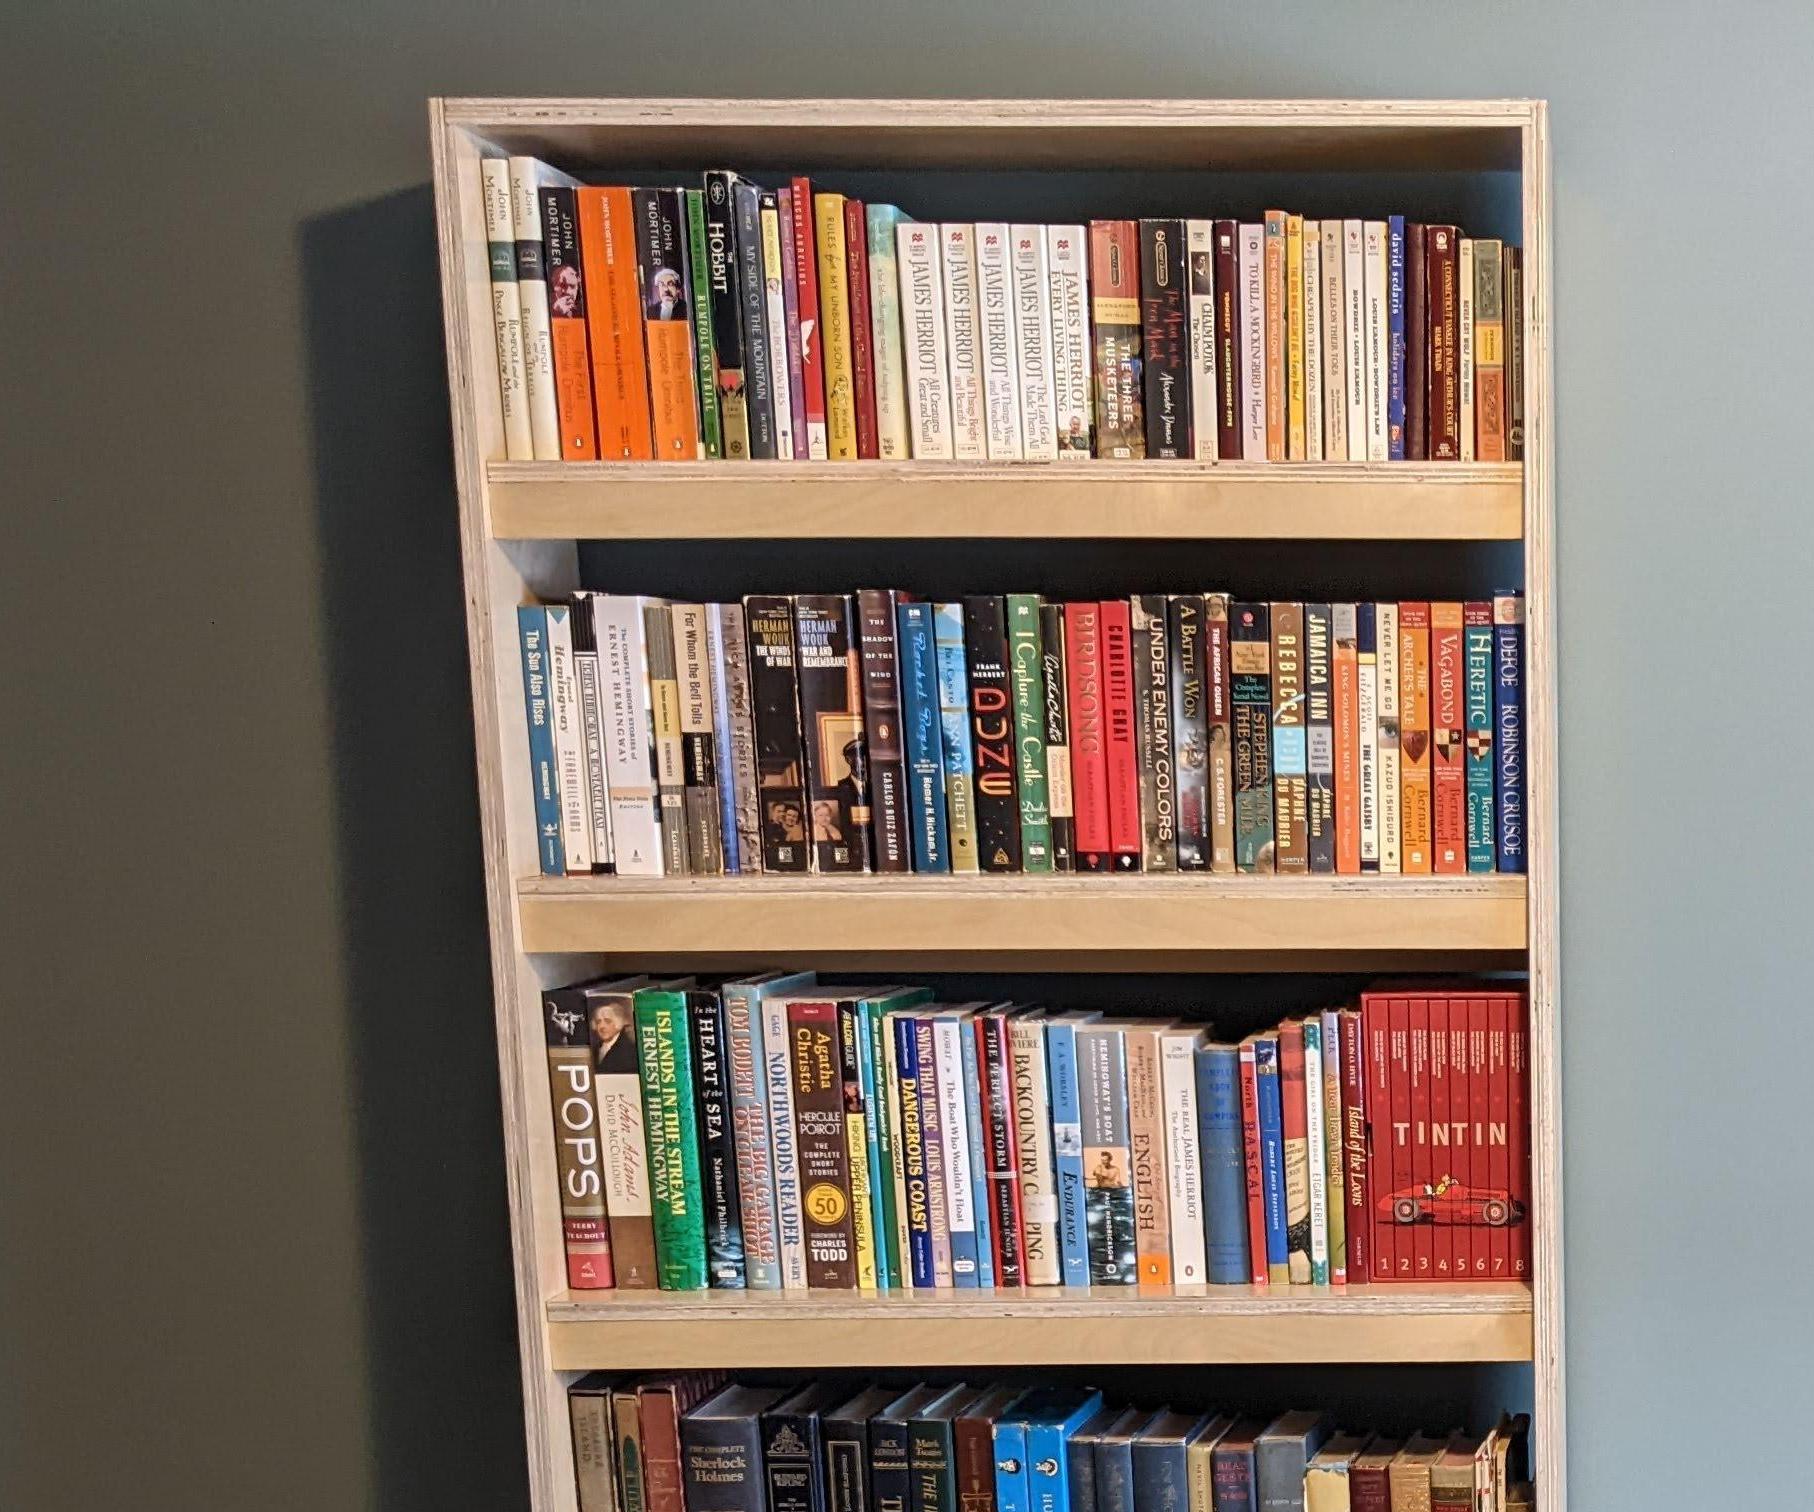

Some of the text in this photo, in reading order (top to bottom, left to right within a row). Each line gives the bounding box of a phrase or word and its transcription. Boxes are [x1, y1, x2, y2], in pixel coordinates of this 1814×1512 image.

[547, 197, 561, 265] MORTIMER
[563, 213, 573, 249] JOHN
[648, 201, 661, 266] MORTIMER
[662, 217, 673, 250] JOHN
[708, 223, 728, 294] HOBBIT
[1391, 233, 1403, 315] david sedaris
[746, 246, 767, 400] MY SIDE OF THE MOUNTAIN
[909, 259, 937, 374] JAMES HERRIOT
[947, 259, 974, 373] JAMES HERRIOT
[981, 263, 1008, 377] JAMES HERRIOT
[1016, 266, 1043, 381] JAMES HERRIOT
[1051, 271, 1068, 412] EVERY LIVING THING
[1062, 271, 1085, 413] JAMES HERRIOT
[702, 355, 711, 371] ON
[703, 377, 714, 412] TRIAL
[1105, 337, 1118, 429] MUSKETEERS
[1120, 344, 1133, 422] THE THREE
[527, 631, 545, 725] The Sun Also Rises
[685, 613, 703, 725] For Whom the Bell Tolls
[1014, 642, 1035, 706] Capture
[1074, 611, 1099, 754] BIRDSONG
[1279, 634, 1298, 724] REBECCA
[1310, 614, 1327, 720] JAMAICA INN
[1438, 634, 1458, 724] VAGABOND
[1470, 634, 1491, 724] HERETIC
[1020, 709, 1037, 729] the
[1022, 737, 1043, 786] Castle
[1149, 619, 1172, 841] UNDER ENEMY COLORS
[1501, 637, 1520, 855] DEFOE ROBINSON CRUSOE
[1468, 792, 1479, 848] Cornwell
[1482, 796, 1493, 844] Bernard
[699, 1019, 722, 1140] HEART SEA
[797, 1028, 814, 1093] Christie
[814, 1032, 833, 1089] Agatha
[987, 1030, 1006, 1167] THE PERFECT STORM
[557, 1065, 600, 1199] POPS
[642, 1026, 668, 1203] ERNEST HEMINGWAY
[656, 1011, 686, 1215] ISLANDS IN THE STREAM
[768, 1052, 800, 1246] NORTHWOODS READER
[901, 1078, 928, 1232] DANGEROUS COAST
[946, 1081, 965, 1222] The Boat Who Wouldn't Float
[1013, 1054, 1040, 1179] BACKCOUNTRY
[1348, 1106, 1363, 1139] Island
[1393, 1122, 1505, 1145] TINTIN
[1134, 1134, 1154, 1232] ENGLISH
[1350, 1153, 1363, 1170] the
[1351, 1173, 1364, 1207] Loons
[921, 1474, 936, 1501] THE
